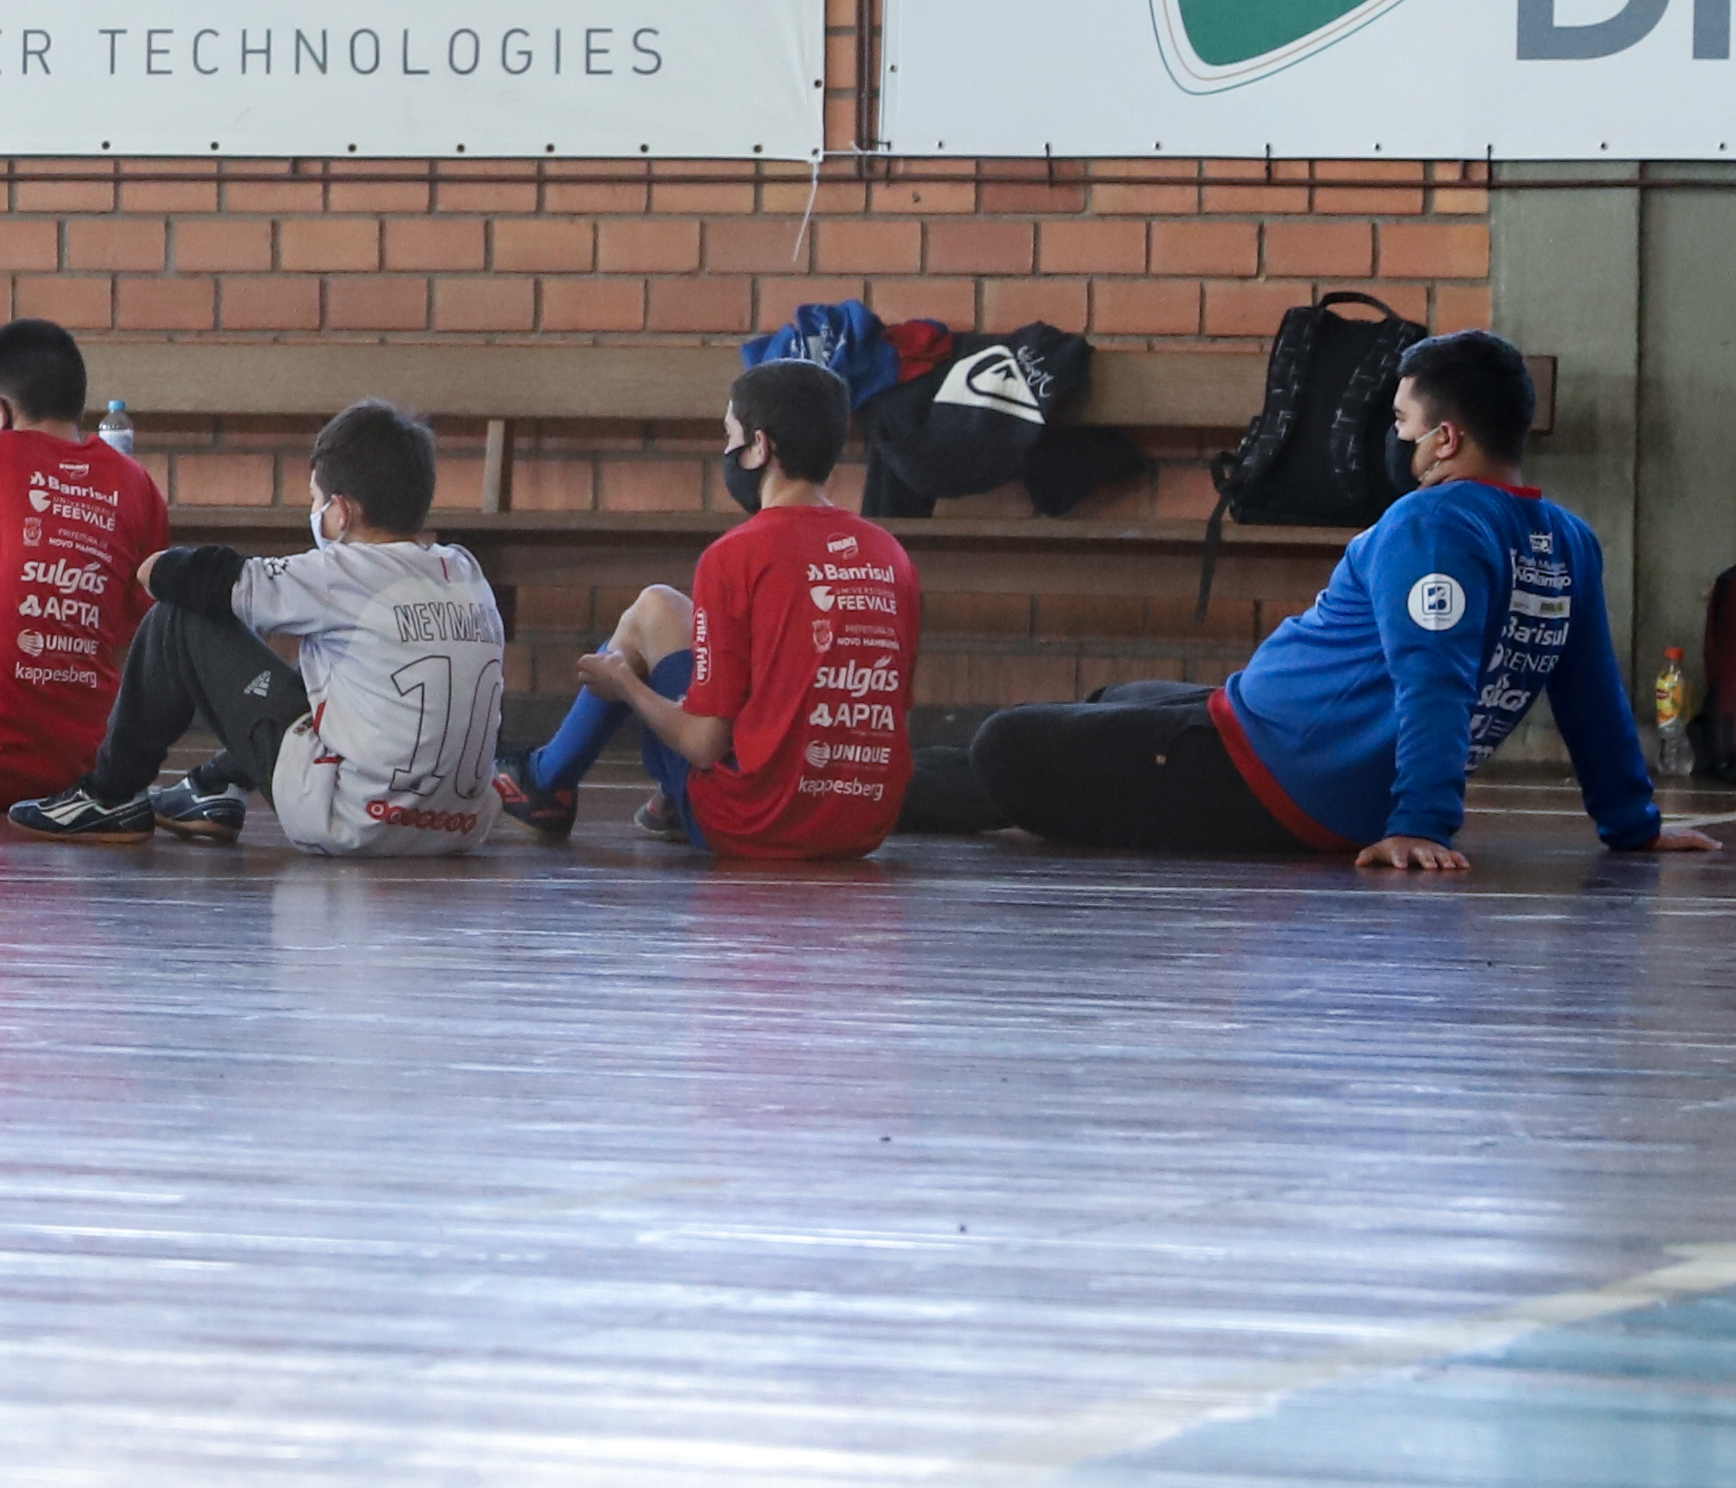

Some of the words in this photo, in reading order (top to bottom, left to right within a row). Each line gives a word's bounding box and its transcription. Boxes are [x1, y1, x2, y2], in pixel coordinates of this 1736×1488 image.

[98, 26, 665, 75] TECHNOLOGIES
[48, 475, 118, 507] Banrisul
[53, 504, 115, 531] FEEVALE
[824, 563, 894, 583] Banrisul
[43, 596, 99, 629] APTA
[837, 595, 897, 615] FEEVALE
[46, 634, 99, 655] UNIQUE
[15, 661, 97, 688] kappesberg
[833, 703, 894, 731] APTA
[832, 744, 891, 764] UNIQUE
[798, 775, 884, 801] kappesberg
